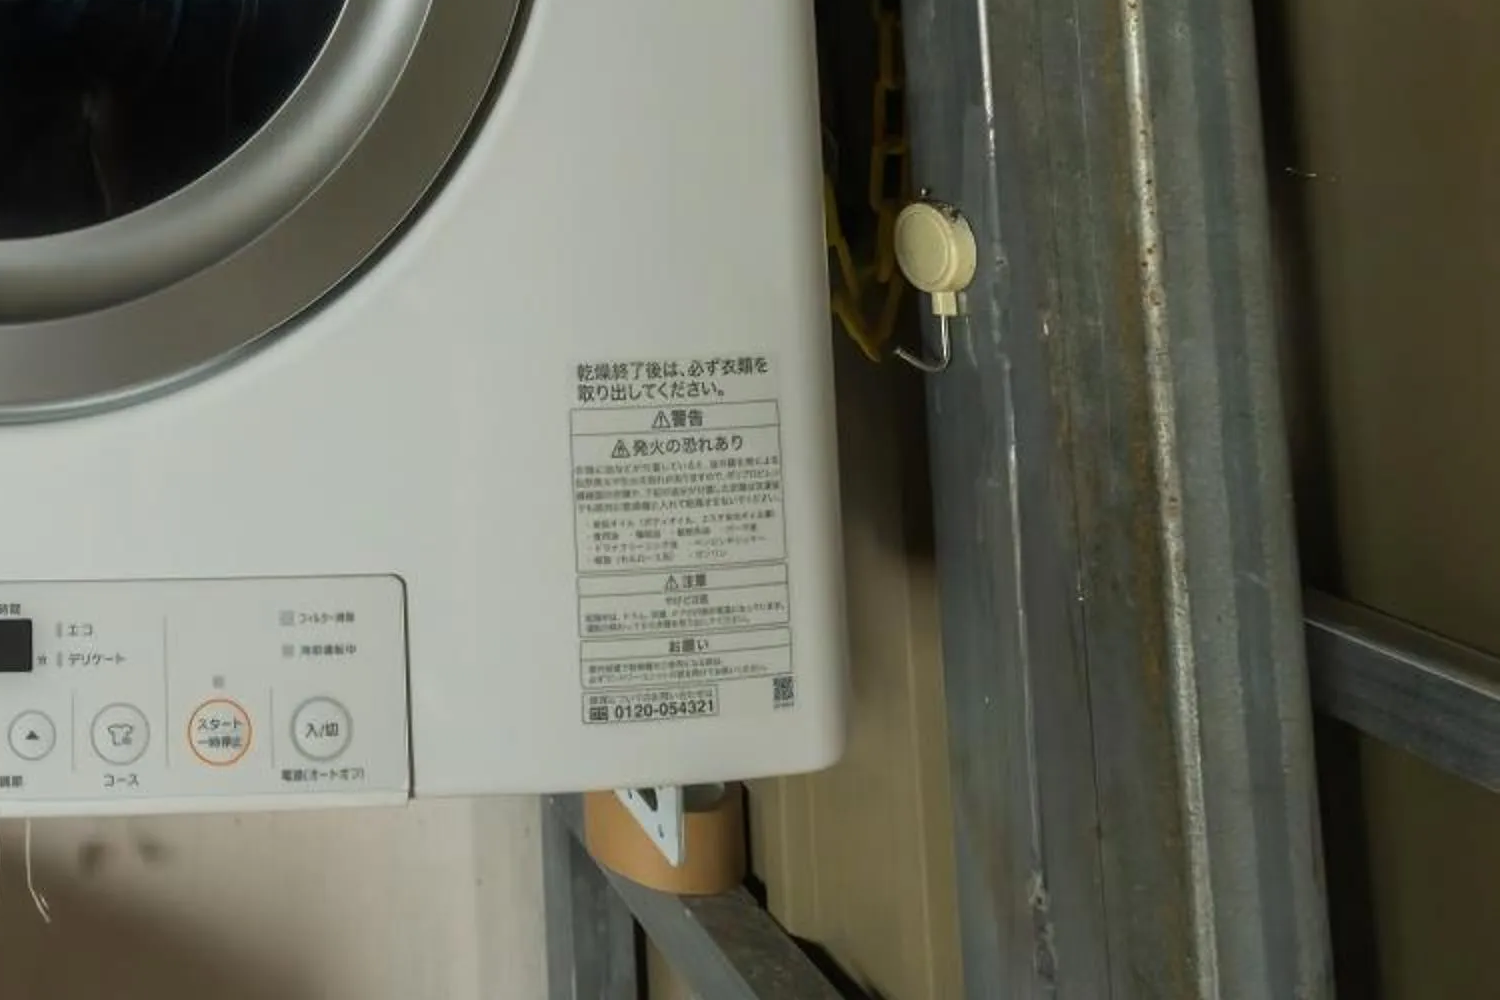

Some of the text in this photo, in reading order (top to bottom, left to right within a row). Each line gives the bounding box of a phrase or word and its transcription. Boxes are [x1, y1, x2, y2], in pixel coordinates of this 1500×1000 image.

[577, 357, 769, 381] 乾燥終了後は、必ず衣類を
[577, 381, 725, 402] 取り出してください。
[671, 409, 704, 427] 警告
[633, 435, 743, 456] 発火の恐れあり
[68, 623, 94, 637] エコ
[68, 652, 126, 667] デリケート
[615, 700, 714, 720] 0120-054321
[197, 717, 243, 731] スタート
[305, 722, 339, 739] 入/切
[103, 773, 140, 788] コース
